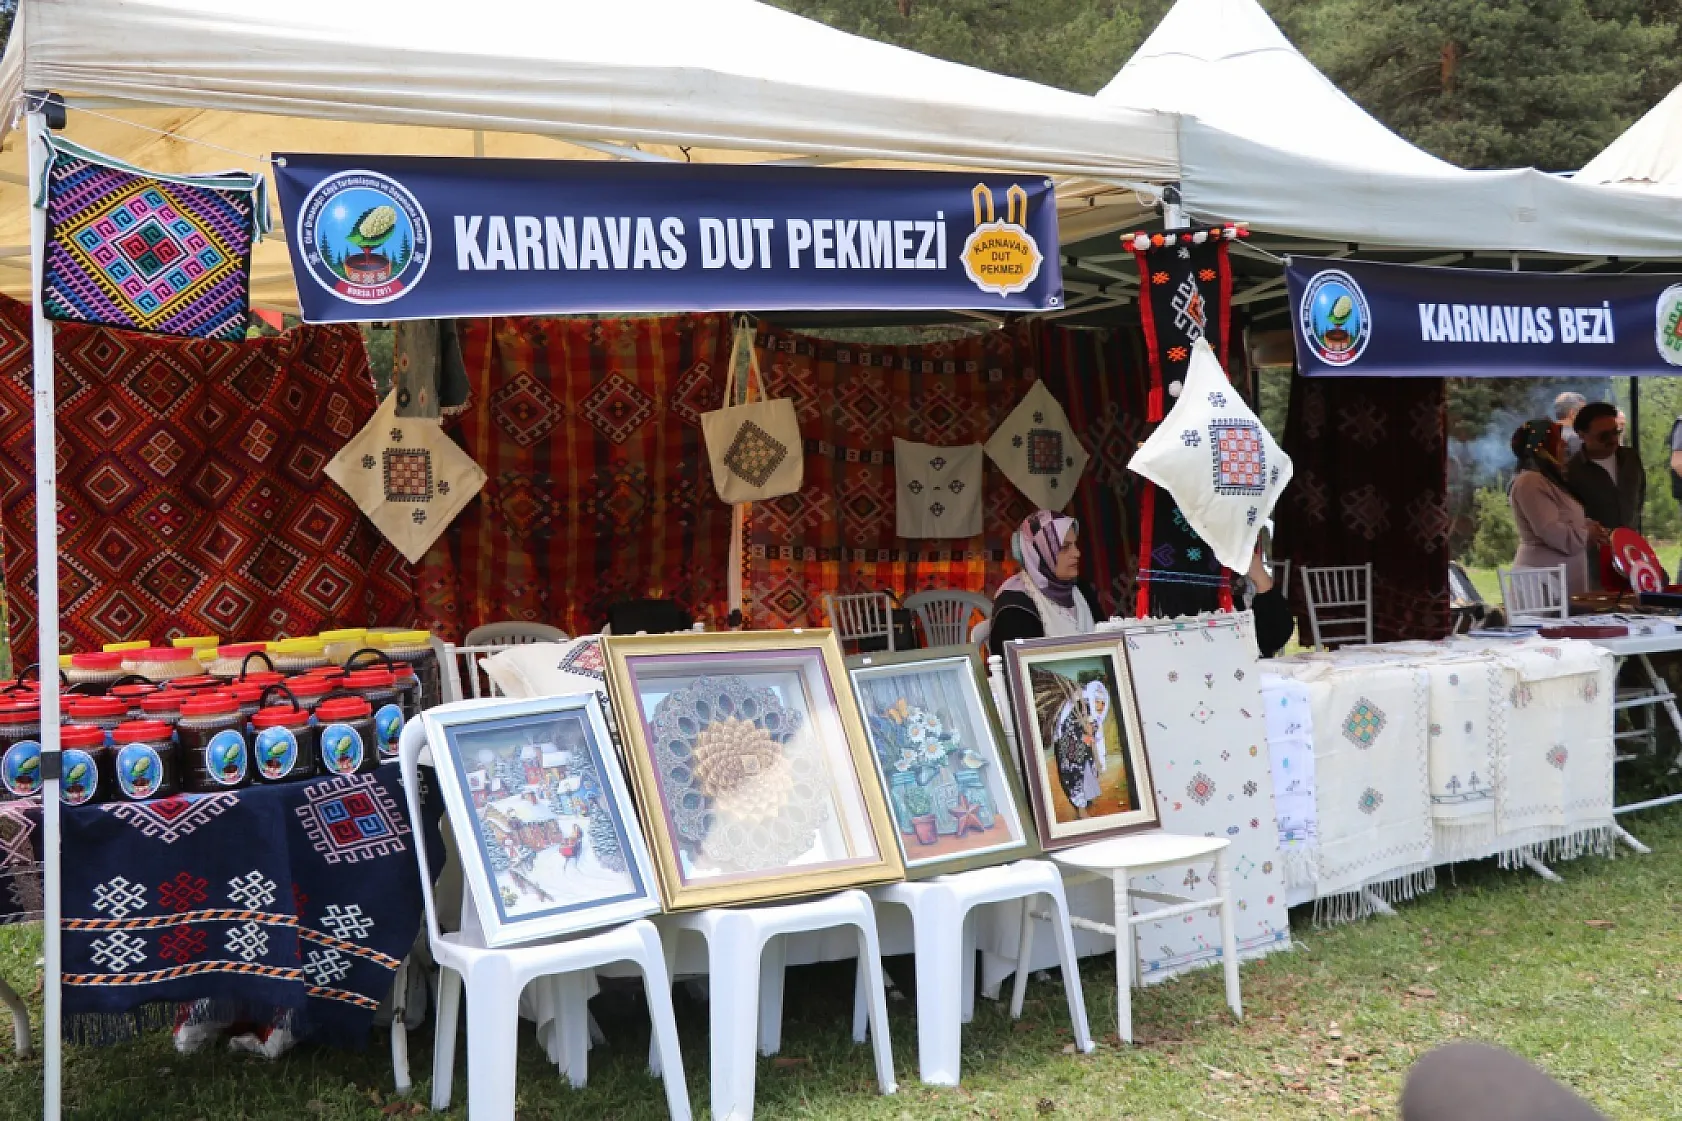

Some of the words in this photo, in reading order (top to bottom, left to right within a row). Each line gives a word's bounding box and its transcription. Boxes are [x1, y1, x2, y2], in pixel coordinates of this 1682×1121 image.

[453, 215, 688, 270] KARNAVAS
[699, 217, 776, 270] DUT
[786, 210, 948, 270] PEKMEZİ
[973, 238, 1029, 256] KARNAVAS
[991, 251, 1011, 261] DUT
[980, 262, 1024, 274] PEKMEZİ
[1418, 303, 1554, 343] KARNAVAS
[1558, 300, 1616, 343] BEZİ
